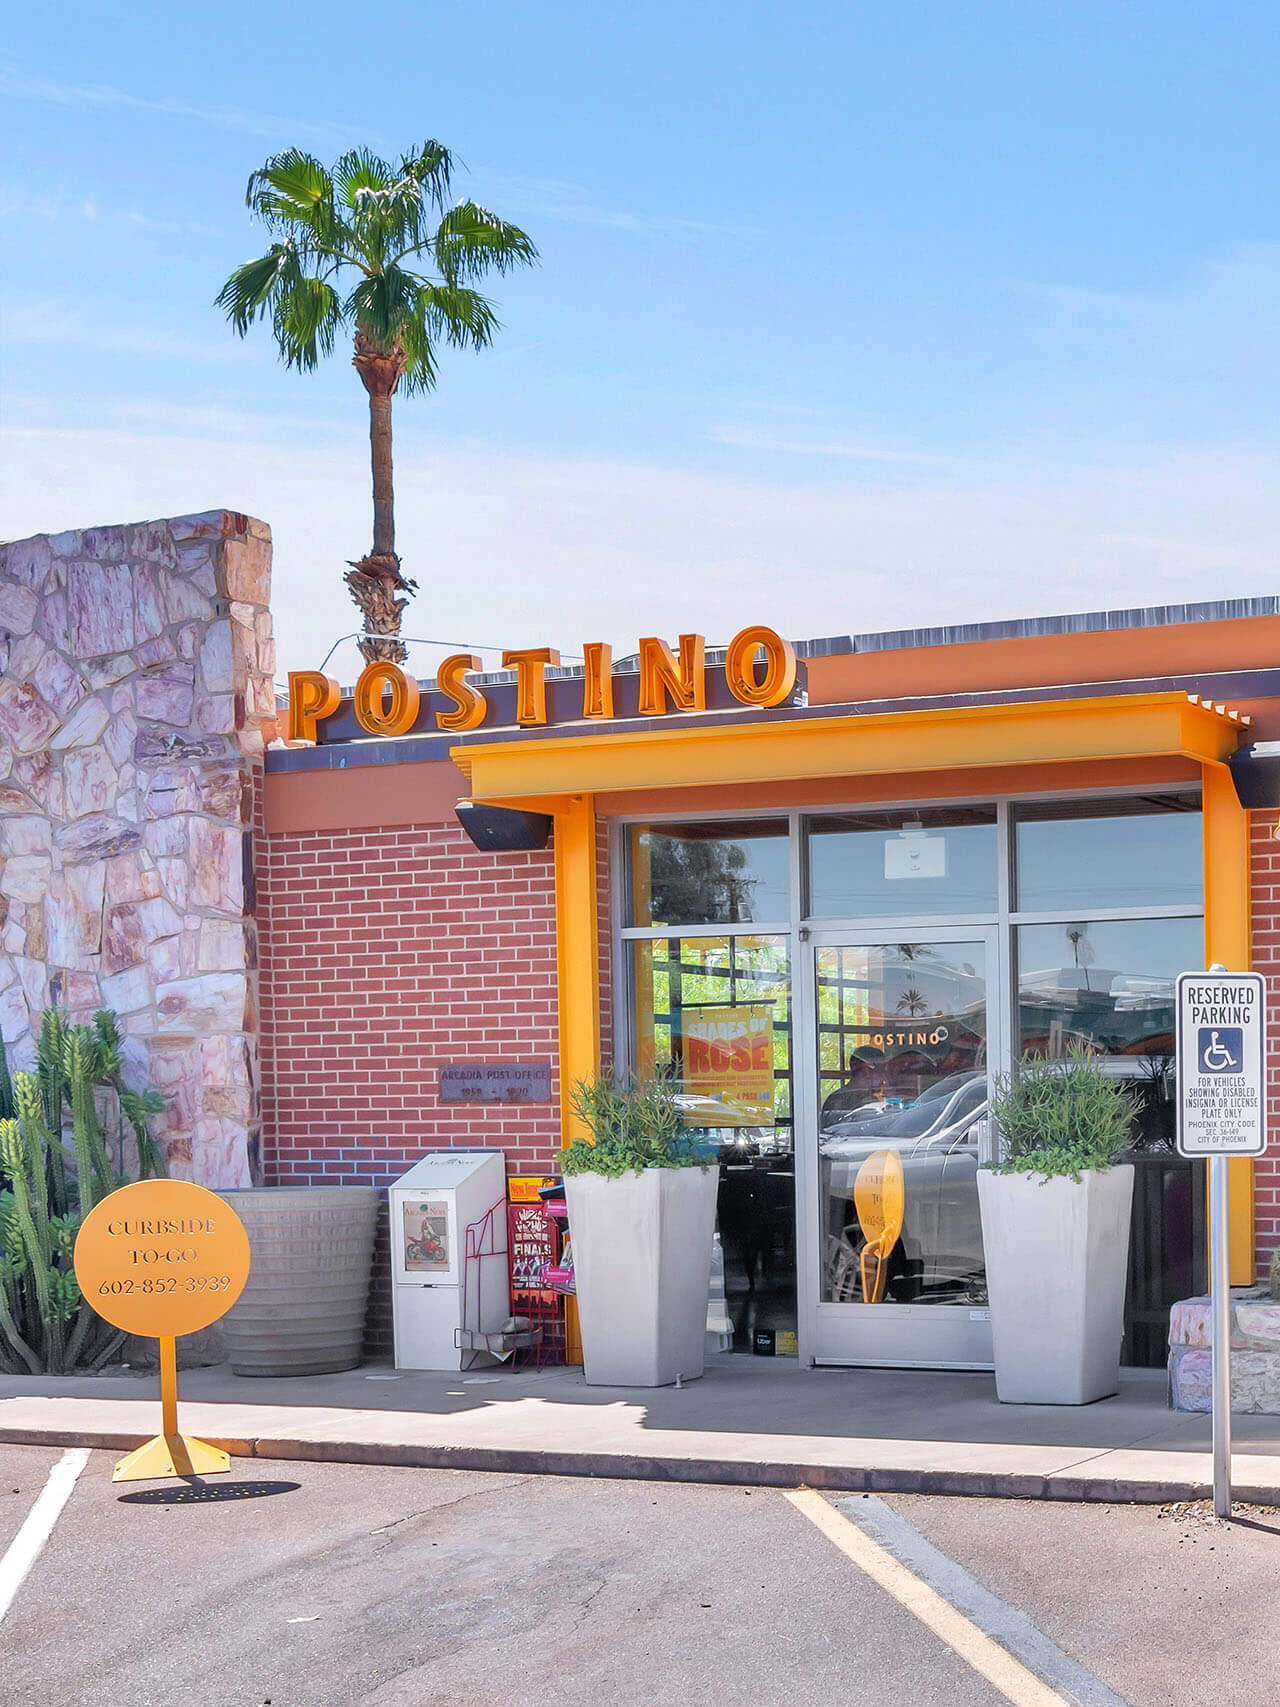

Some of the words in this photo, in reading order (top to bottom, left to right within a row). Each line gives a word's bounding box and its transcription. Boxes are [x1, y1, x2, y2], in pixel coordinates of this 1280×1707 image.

[288, 625, 797, 746] POSTINO
[1188, 987, 1254, 1005] RESERVED
[1192, 1007, 1250, 1024] PARKING
[687, 1021, 748, 1040] SHADES
[864, 1032, 940, 1046] POSTINO
[441, 1070, 482, 1080] ARCADIA
[487, 1070, 510, 1080] POST
[514, 1070, 546, 1080] OFFICE
[1198, 1077, 1211, 1087] FOR
[1214, 1077, 1245, 1086] VEHICLES
[1189, 1088, 1220, 1097] SHOWING
[1223, 1088, 1255, 1097] DISABLED
[1186, 1098, 1216, 1108] INSIGNIA
[1219, 1099, 1228, 1107] OR
[1231, 1098, 1258, 1107] LICENSE
[1202, 1109, 1221, 1118] PLATE
[1224, 1109, 1242, 1118] ONLY
[108, 1219, 216, 1236] CURBSIDE
[128, 1249, 198, 1265] TO-GO
[514, 1243, 552, 1256] FINALS
[98, 1276, 231, 1296] 602-852-3939
